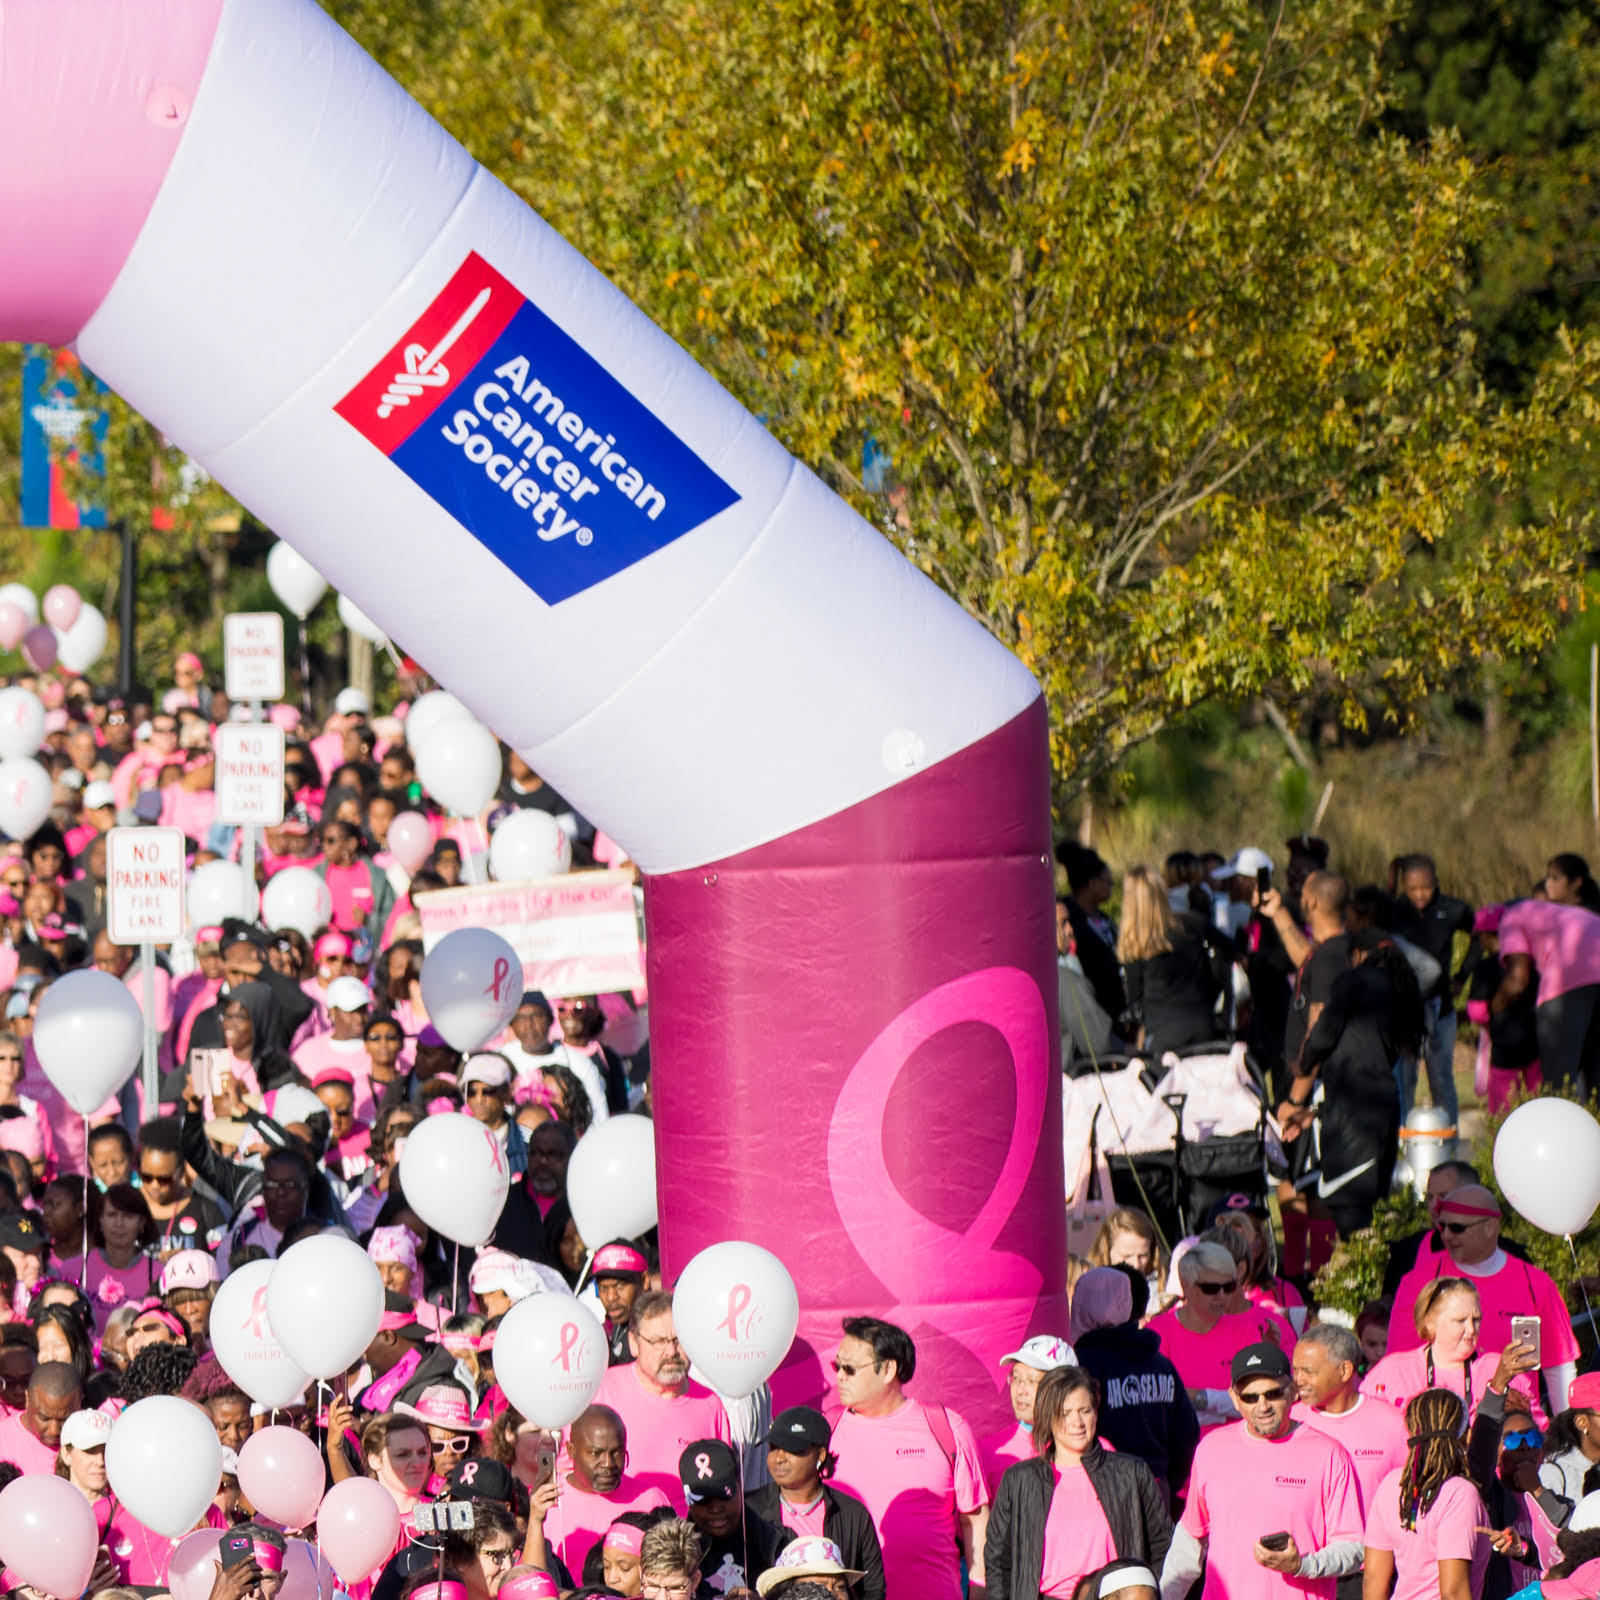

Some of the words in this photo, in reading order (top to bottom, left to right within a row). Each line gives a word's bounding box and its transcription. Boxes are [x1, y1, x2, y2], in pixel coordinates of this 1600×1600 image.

[473, 382, 600, 502] Cancer
[494, 355, 666, 521] American
[239, 738, 263, 754] NO
[223, 760, 279, 778] PARKING
[233, 799, 264, 813] LANE
[133, 844, 159, 861] NO
[115, 870, 178, 889] PARKING
[131, 896, 160, 909] FIRE
[129, 915, 165, 929] LANE
[896, 1448, 926, 1456] Canon
[1275, 1475, 1306, 1485] Canon
